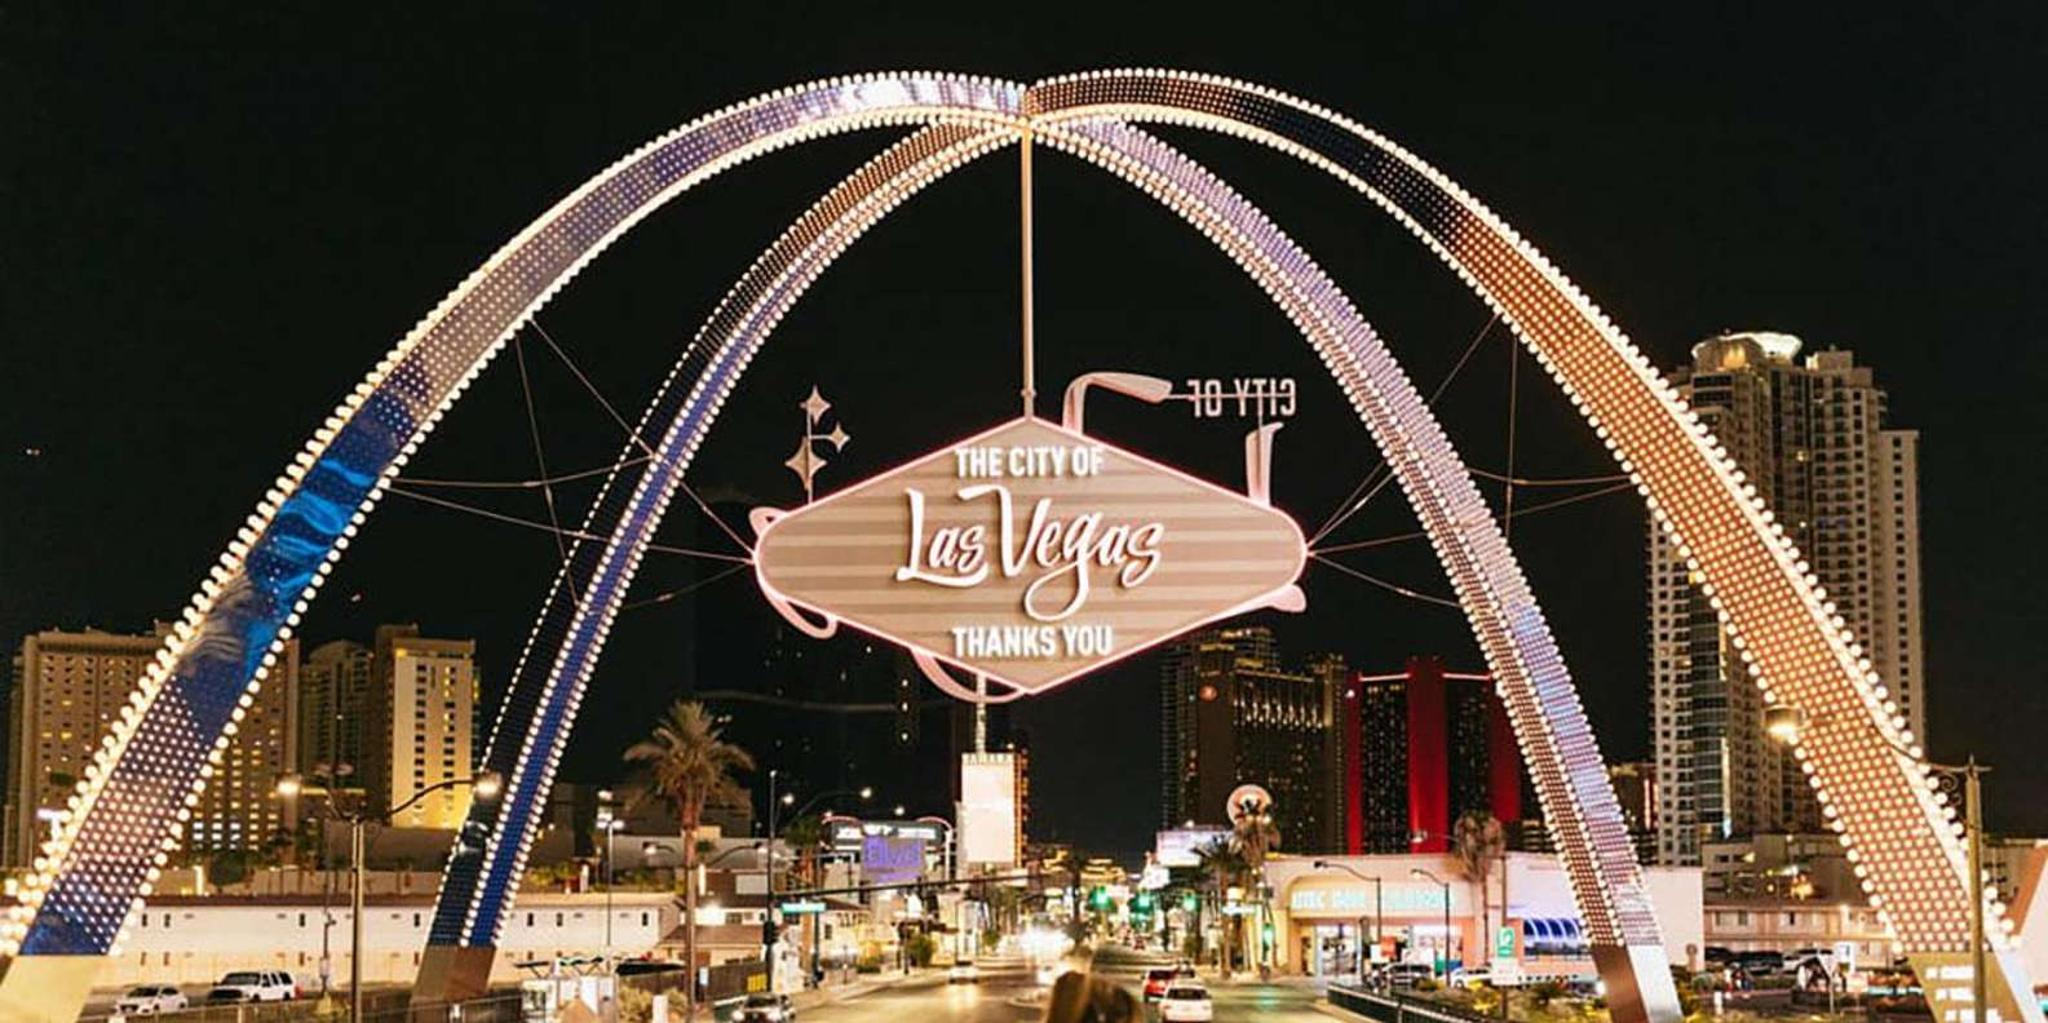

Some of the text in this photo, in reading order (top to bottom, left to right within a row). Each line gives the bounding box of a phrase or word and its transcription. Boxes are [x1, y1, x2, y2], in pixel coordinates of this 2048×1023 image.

[955, 446, 1104, 477] THE CITY OF
[896, 484, 1164, 622] Las Vegas
[951, 624, 1113, 657] THANKS YOU
